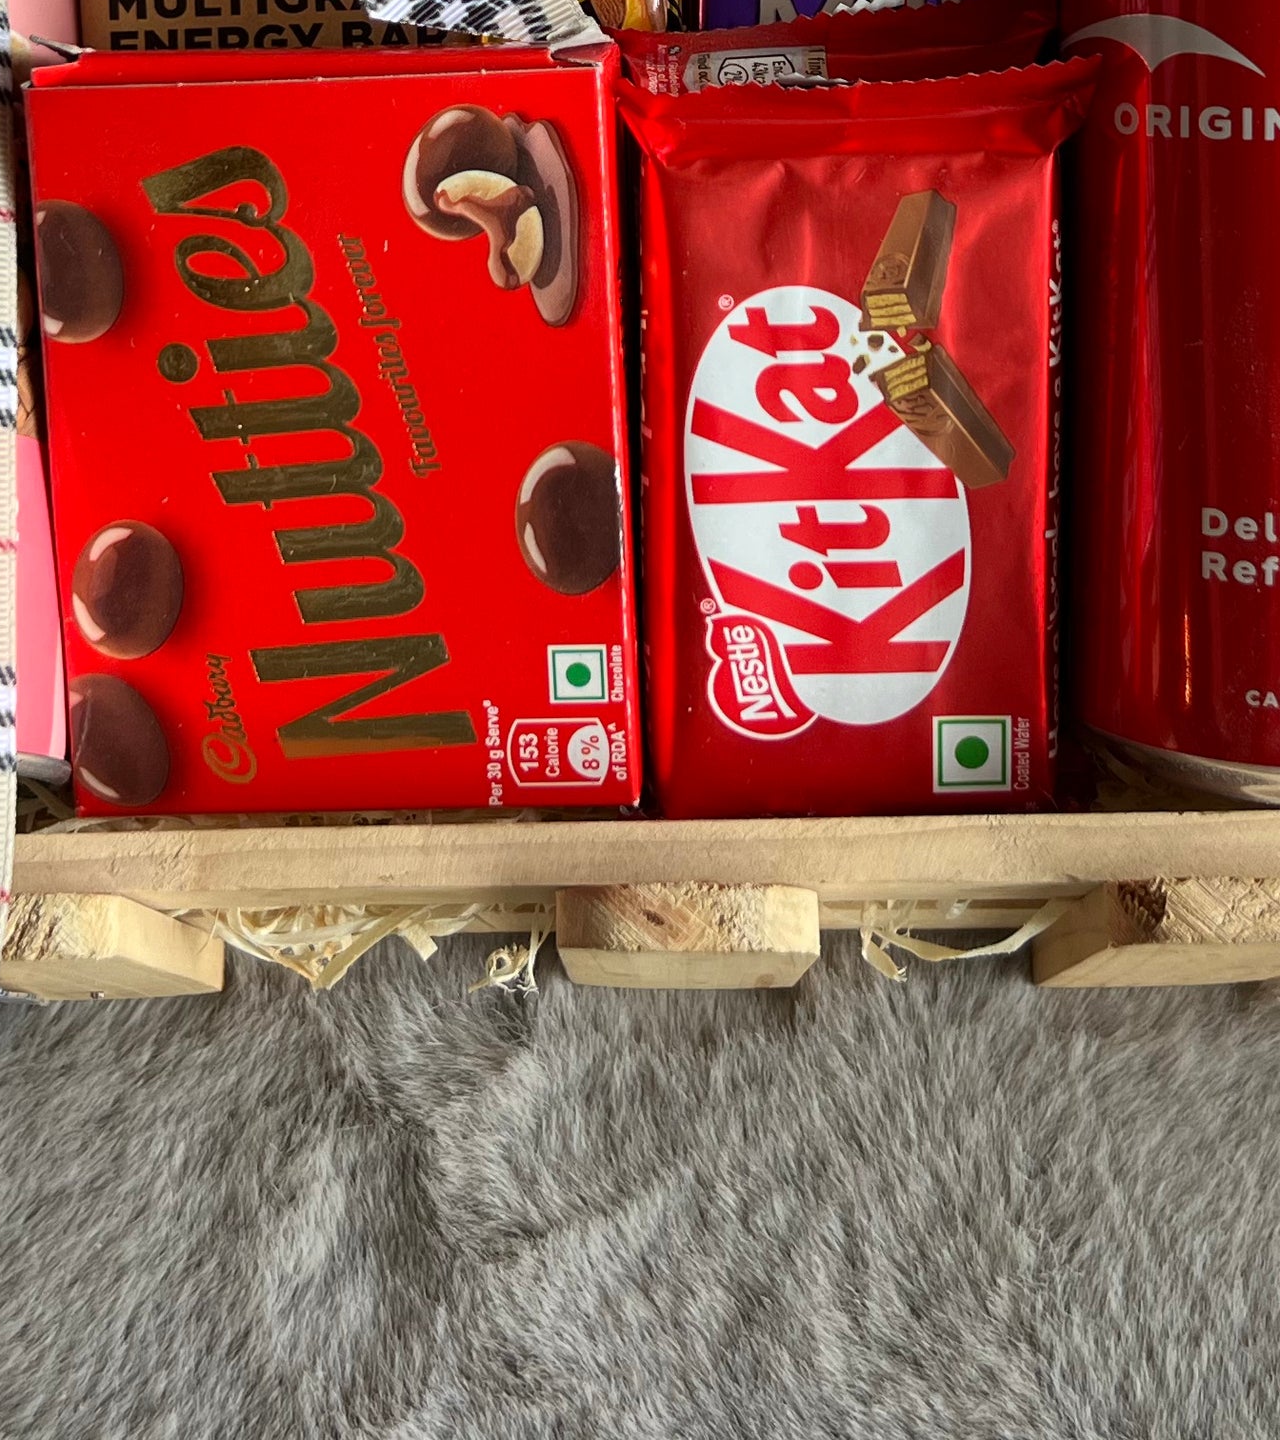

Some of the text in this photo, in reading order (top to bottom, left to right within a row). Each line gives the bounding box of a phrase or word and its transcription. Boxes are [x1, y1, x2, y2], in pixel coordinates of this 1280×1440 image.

[336, 232, 443, 478] Favourites forever
[141, 144, 478, 759] Nutties
[689, 304, 967, 676] KitKat
[609, 644, 625, 702] Chocolate
[202, 652, 260, 785] Cadbury
[487, 762, 503, 780] 30
[489, 749, 505, 760] g
[518, 732, 540, 772] 153
[543, 726, 561, 778] Calorie
[580, 734, 601, 770] 8%
[613, 767, 628, 781] of
[1013, 716, 1030, 791] Coated Wafer
[488, 781, 504, 806] Per
